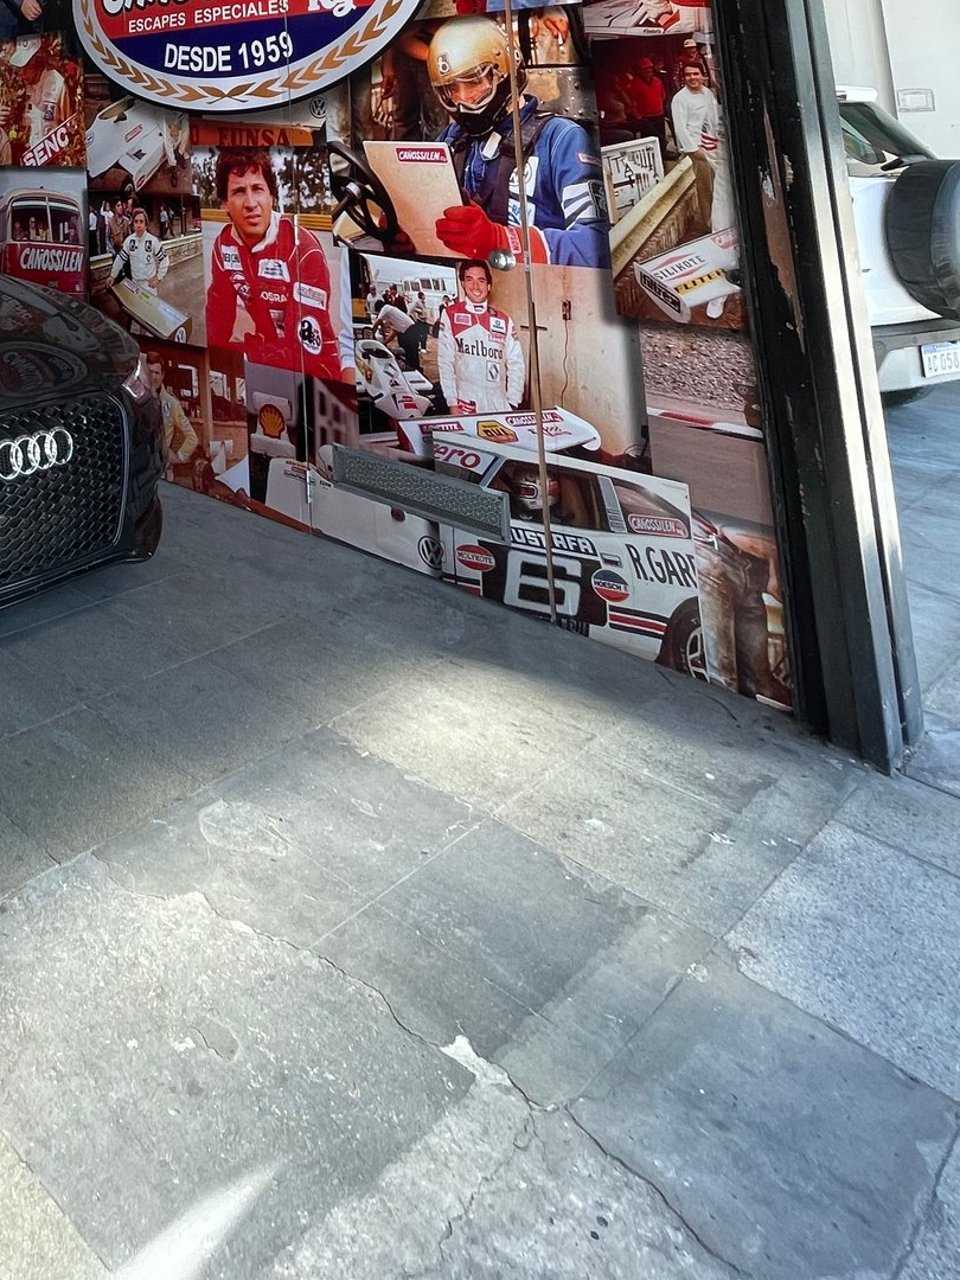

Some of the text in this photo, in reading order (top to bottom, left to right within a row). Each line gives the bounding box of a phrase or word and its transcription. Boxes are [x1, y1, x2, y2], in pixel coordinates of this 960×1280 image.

[128, 12, 187, 33] ESCAPES
[163, 31, 294, 72] DESDE 1959
[20, 247, 83, 272] CAÑOSSILEN
[455, 337, 504, 360] Marlboro
[503, 549, 582, 617] 6
